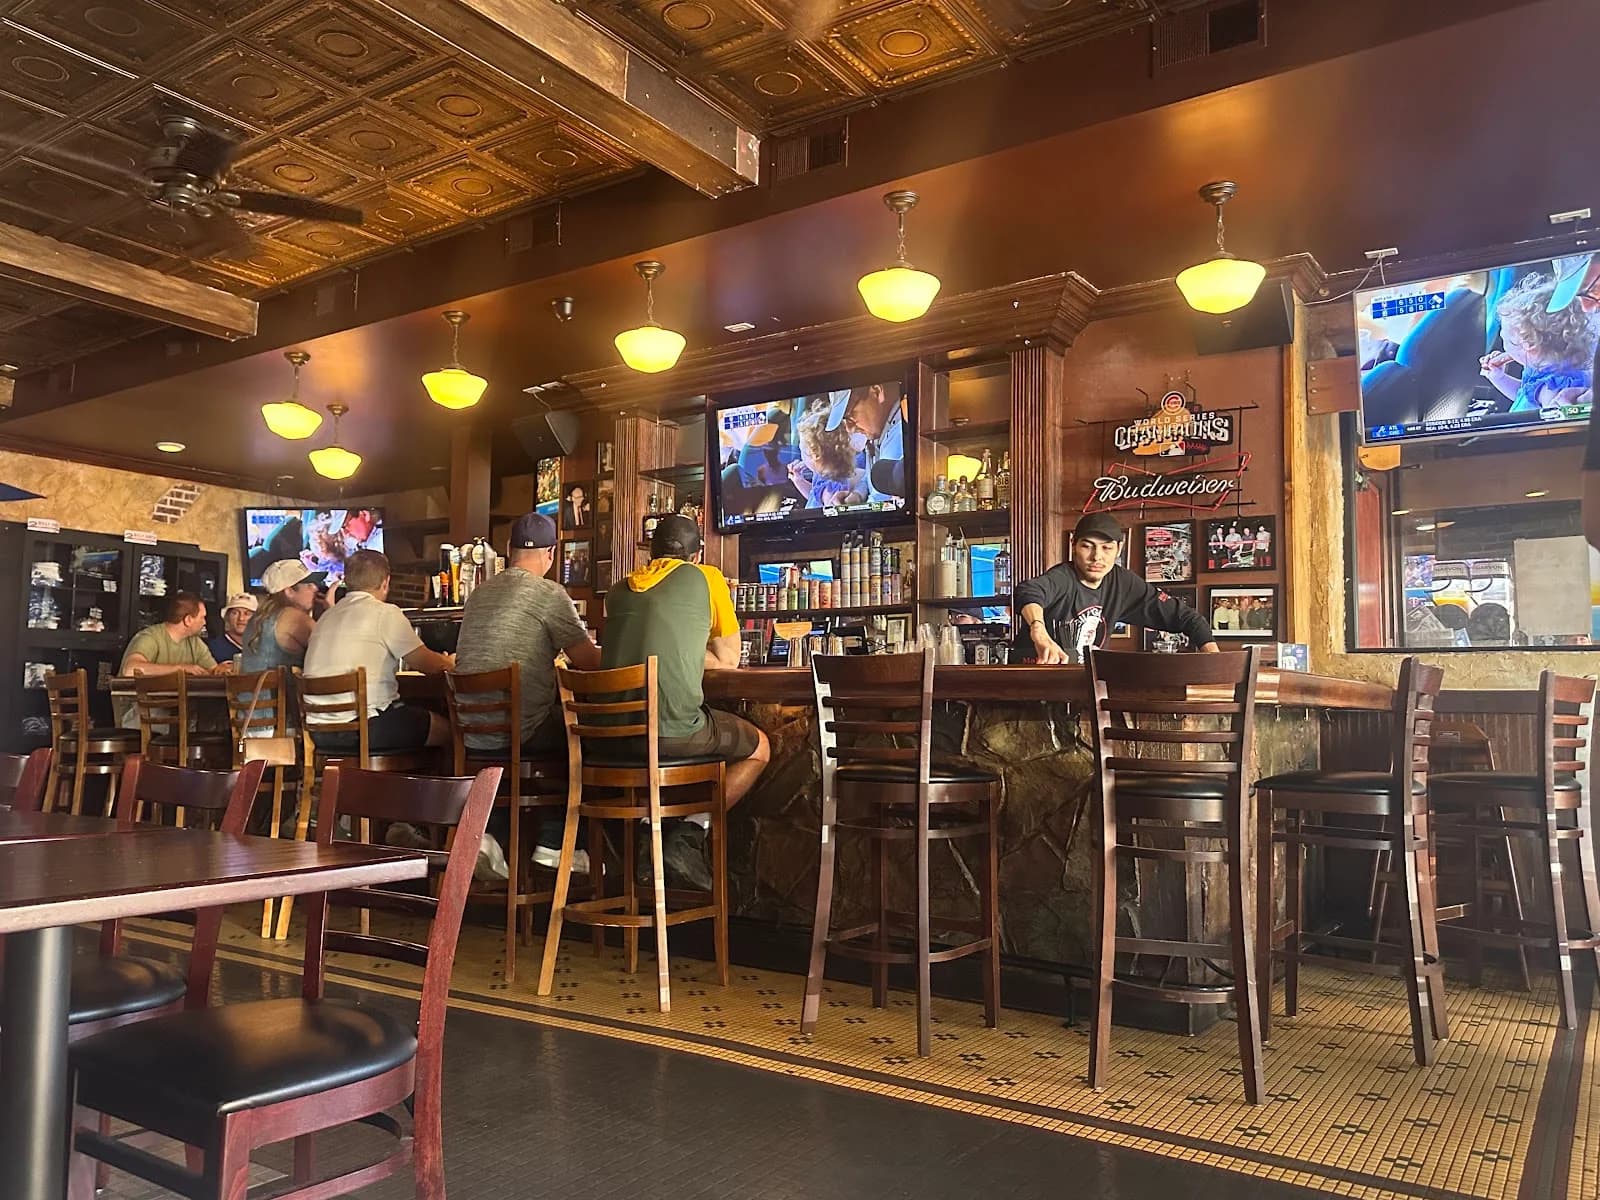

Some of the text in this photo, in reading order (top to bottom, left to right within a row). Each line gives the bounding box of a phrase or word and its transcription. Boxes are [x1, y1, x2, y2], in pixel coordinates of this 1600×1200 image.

[1133, 411, 1216, 426] WORLD SERIES
[1114, 417, 1230, 452] CHAMPIONS
[1093, 474, 1236, 503] Budweiser
